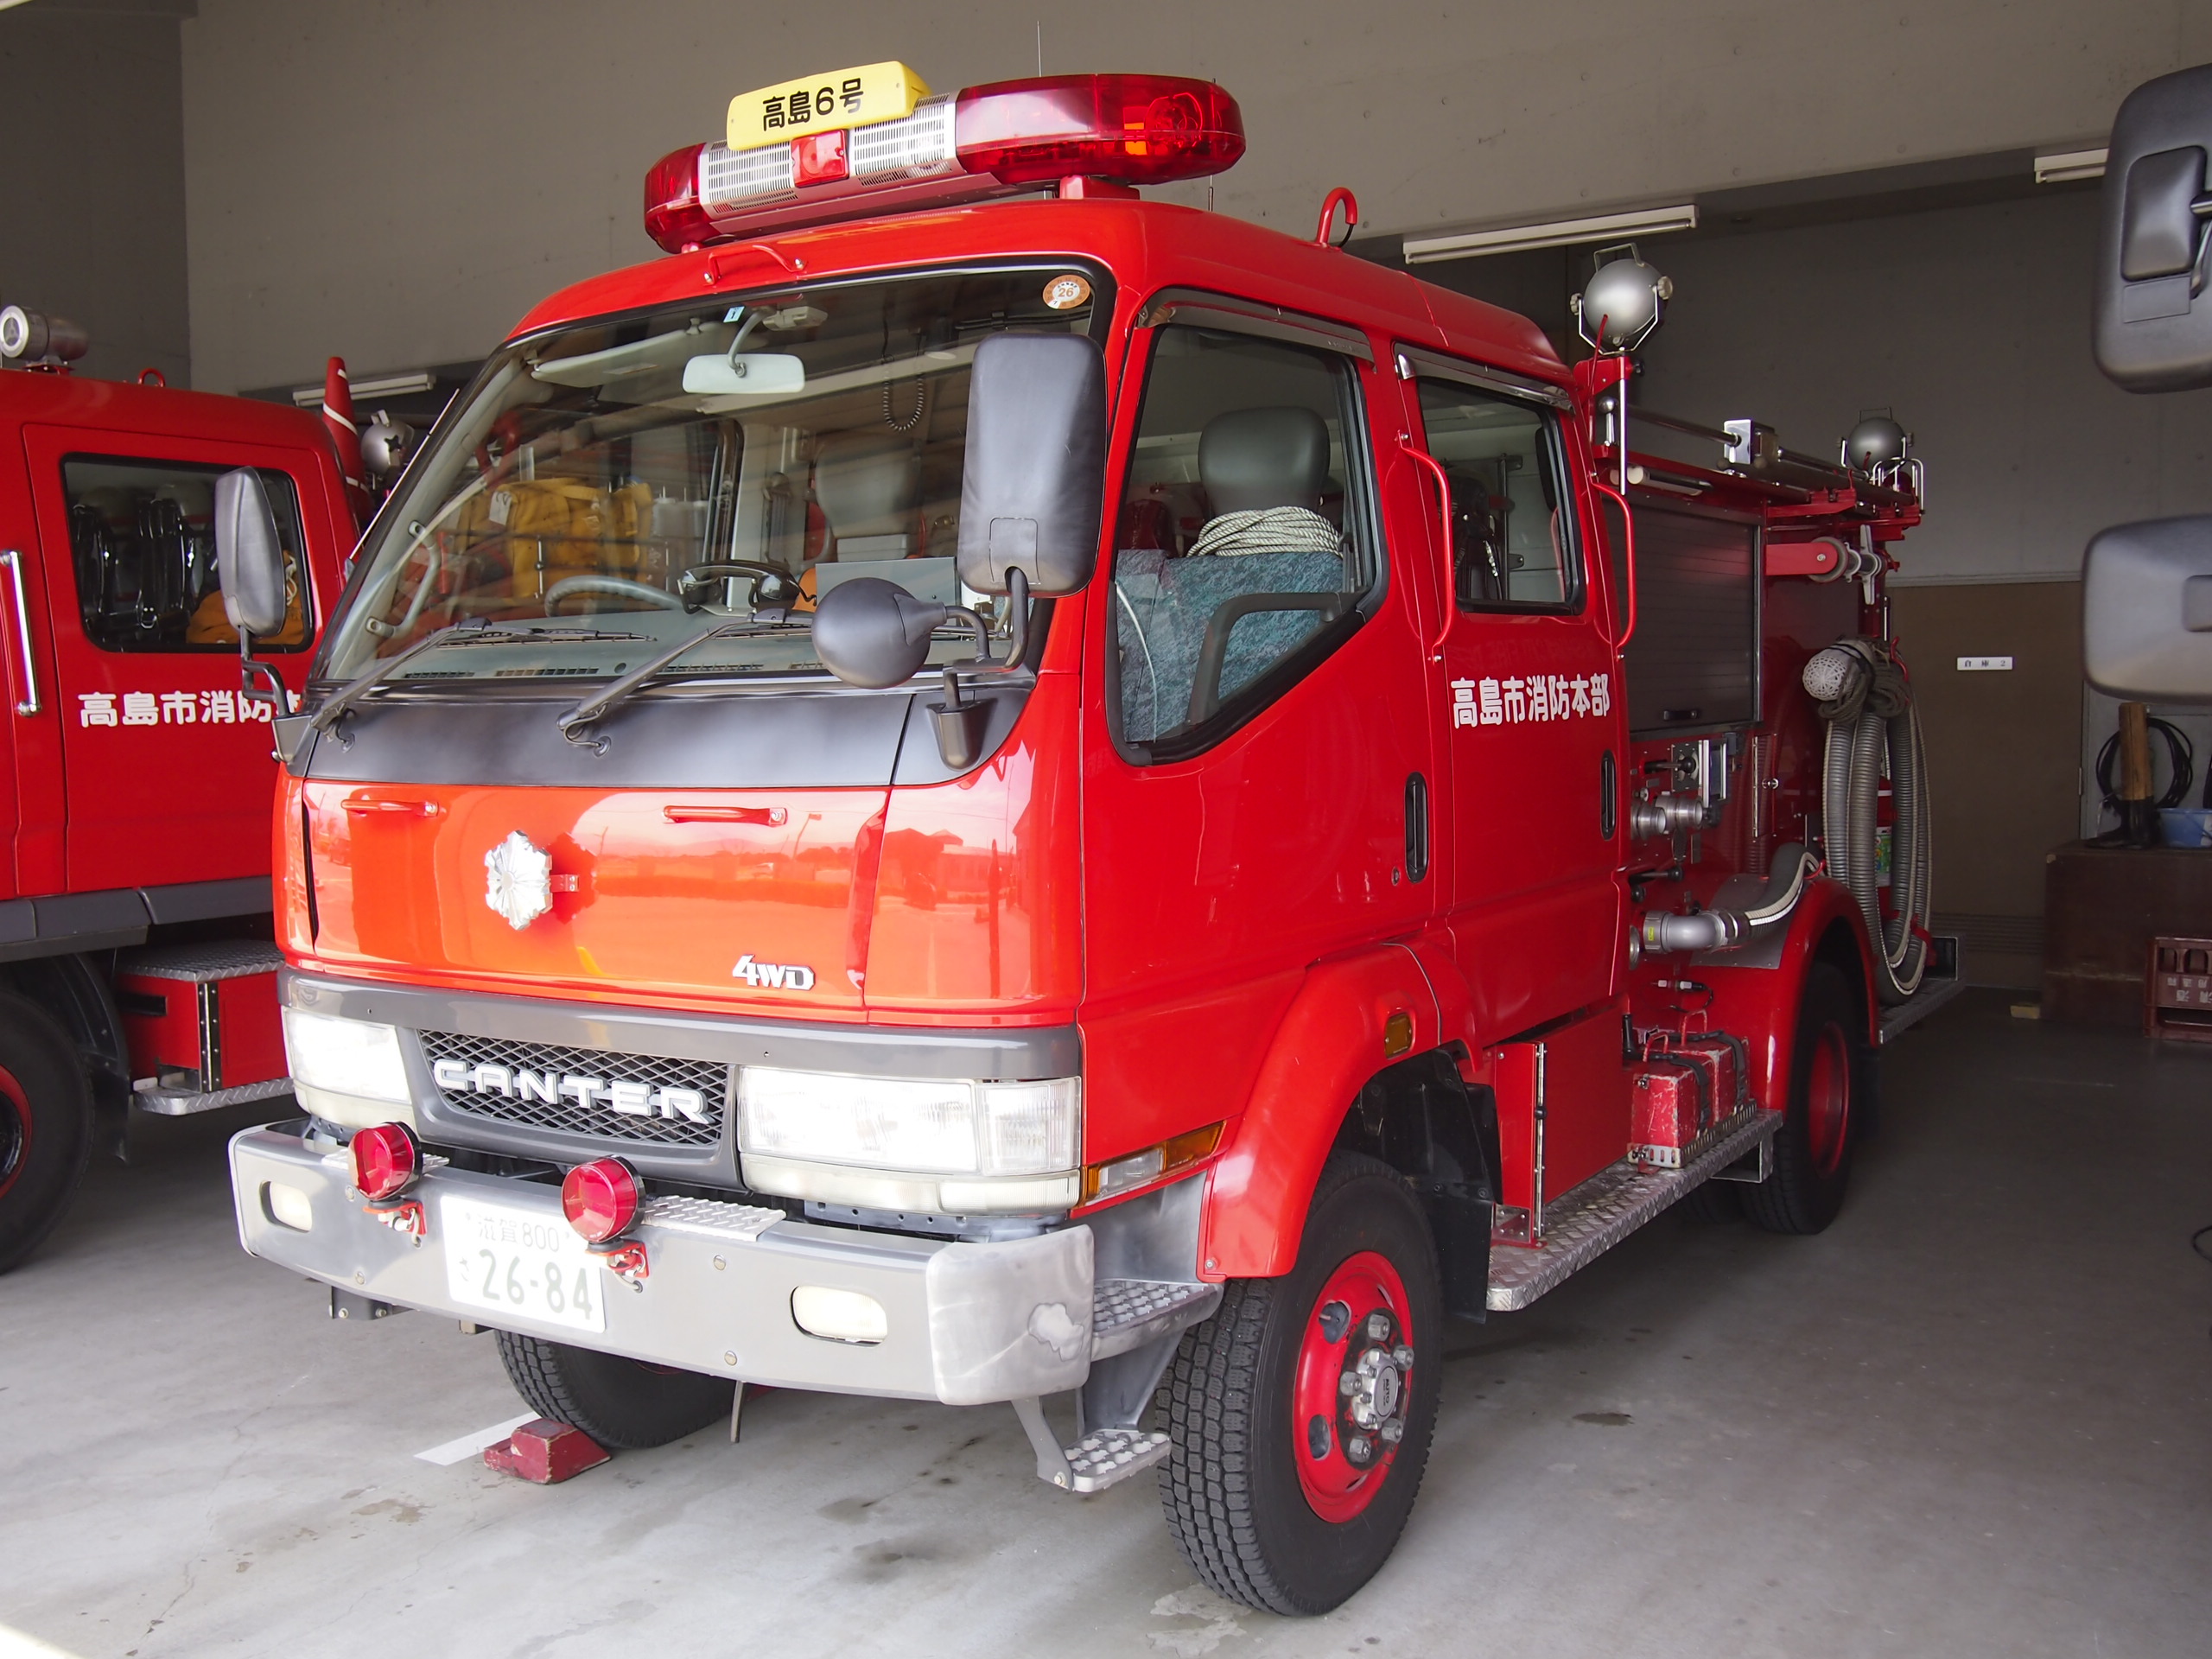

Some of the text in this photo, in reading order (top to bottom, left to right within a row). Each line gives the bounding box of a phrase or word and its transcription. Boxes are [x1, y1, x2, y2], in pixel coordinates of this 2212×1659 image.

[762, 77, 864, 132] 高島6号
[1058, 288, 1074, 297] 26
[1451, 672, 1611, 729] 高島市消防本部
[732, 954, 816, 991] 4WD
[434, 1058, 715, 1124] CANTER
[479, 1249, 593, 1321] 26-84
